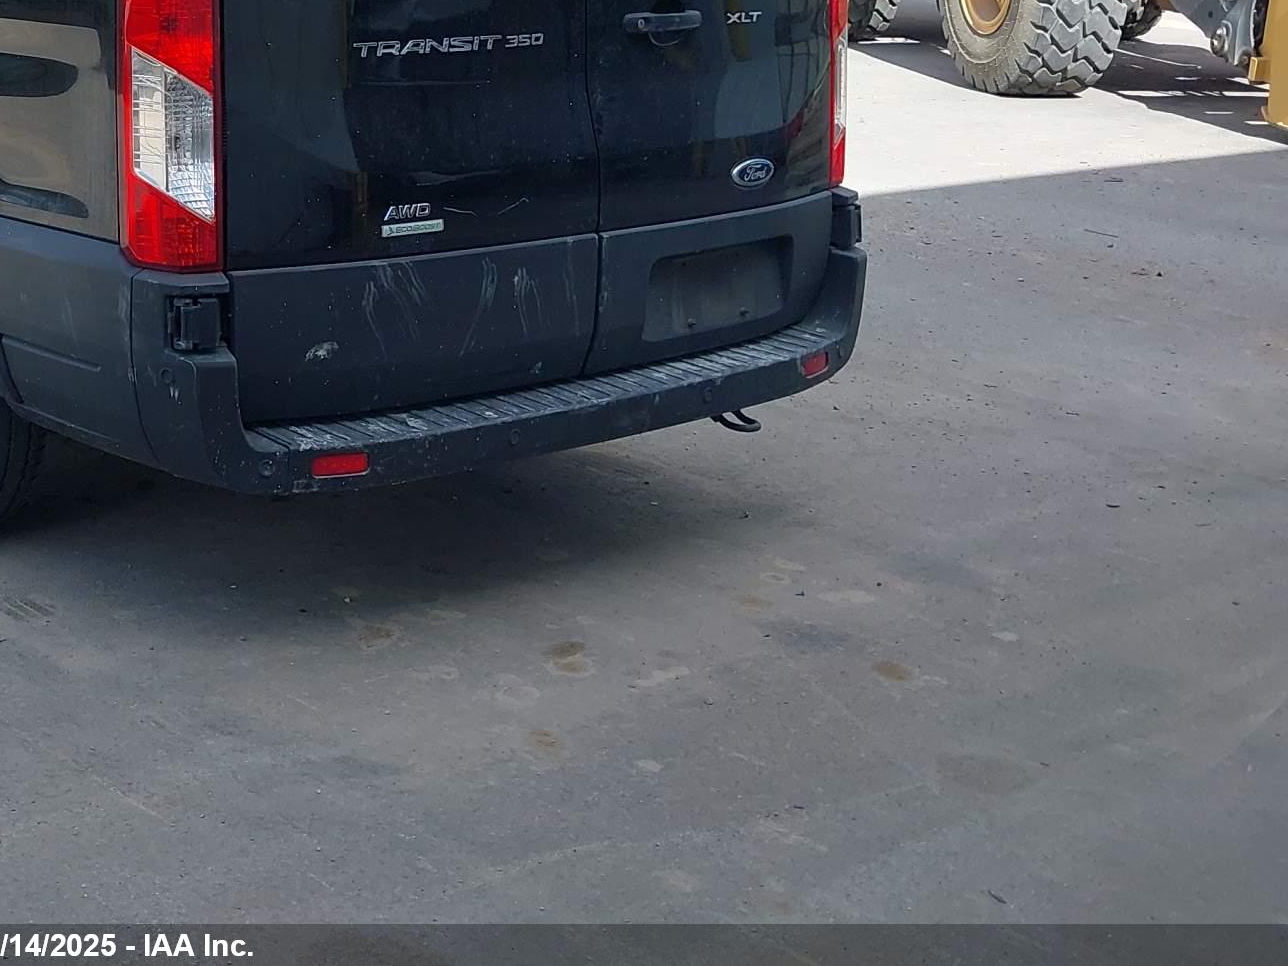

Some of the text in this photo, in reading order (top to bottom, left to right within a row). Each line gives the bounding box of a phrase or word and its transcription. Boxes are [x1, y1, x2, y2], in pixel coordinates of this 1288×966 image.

[727, 11, 762, 24] XLT
[353, 33, 544, 57] TRANSIT 350
[383, 203, 431, 221] AWD
